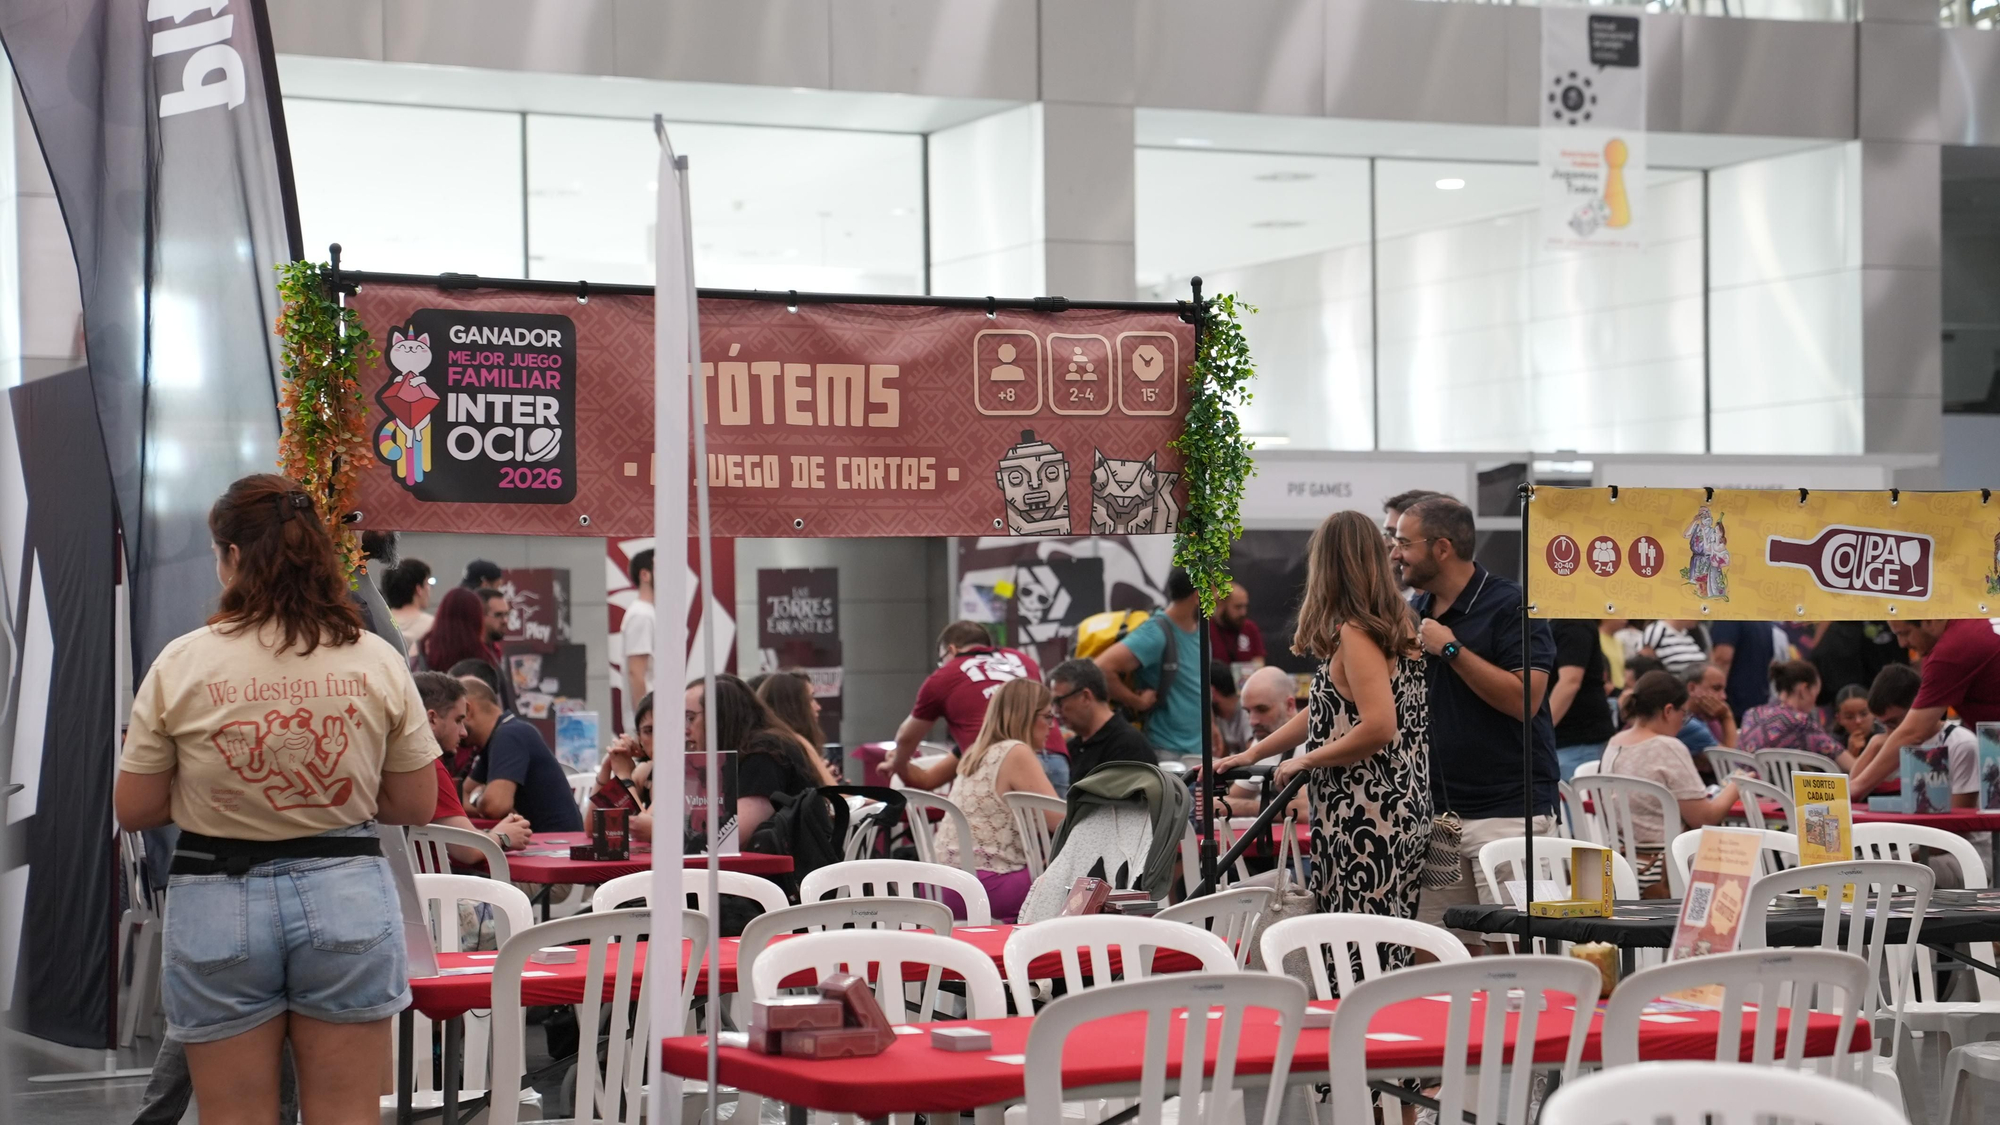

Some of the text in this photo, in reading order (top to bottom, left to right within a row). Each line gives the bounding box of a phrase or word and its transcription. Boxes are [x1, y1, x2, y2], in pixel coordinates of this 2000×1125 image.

[449, 325, 562, 348] GANADOR
[448, 351, 562, 368] MEJOR JUEGO
[447, 368, 561, 390] FAMILIAR
[998, 388, 1015, 401] +8
[1069, 387, 1094, 401] 2-4
[446, 392, 560, 425] INTER
[498, 467, 562, 489] 2026
[694, 454, 779, 489] UEGO
[790, 456, 825, 489] DE
[836, 456, 936, 490] CARTAS
[1288, 481, 1352, 498] PIF GAMES
[1594, 562, 1614, 574] 2-4
[1641, 567, 1652, 576] +8
[766, 595, 833, 619] TORRES
[206, 673, 368, 706] We design fun!
[1803, 779, 1835, 789] UN SORTEO
[685, 795, 724, 806] Valpira
[1807, 791, 1824, 801] CADA
